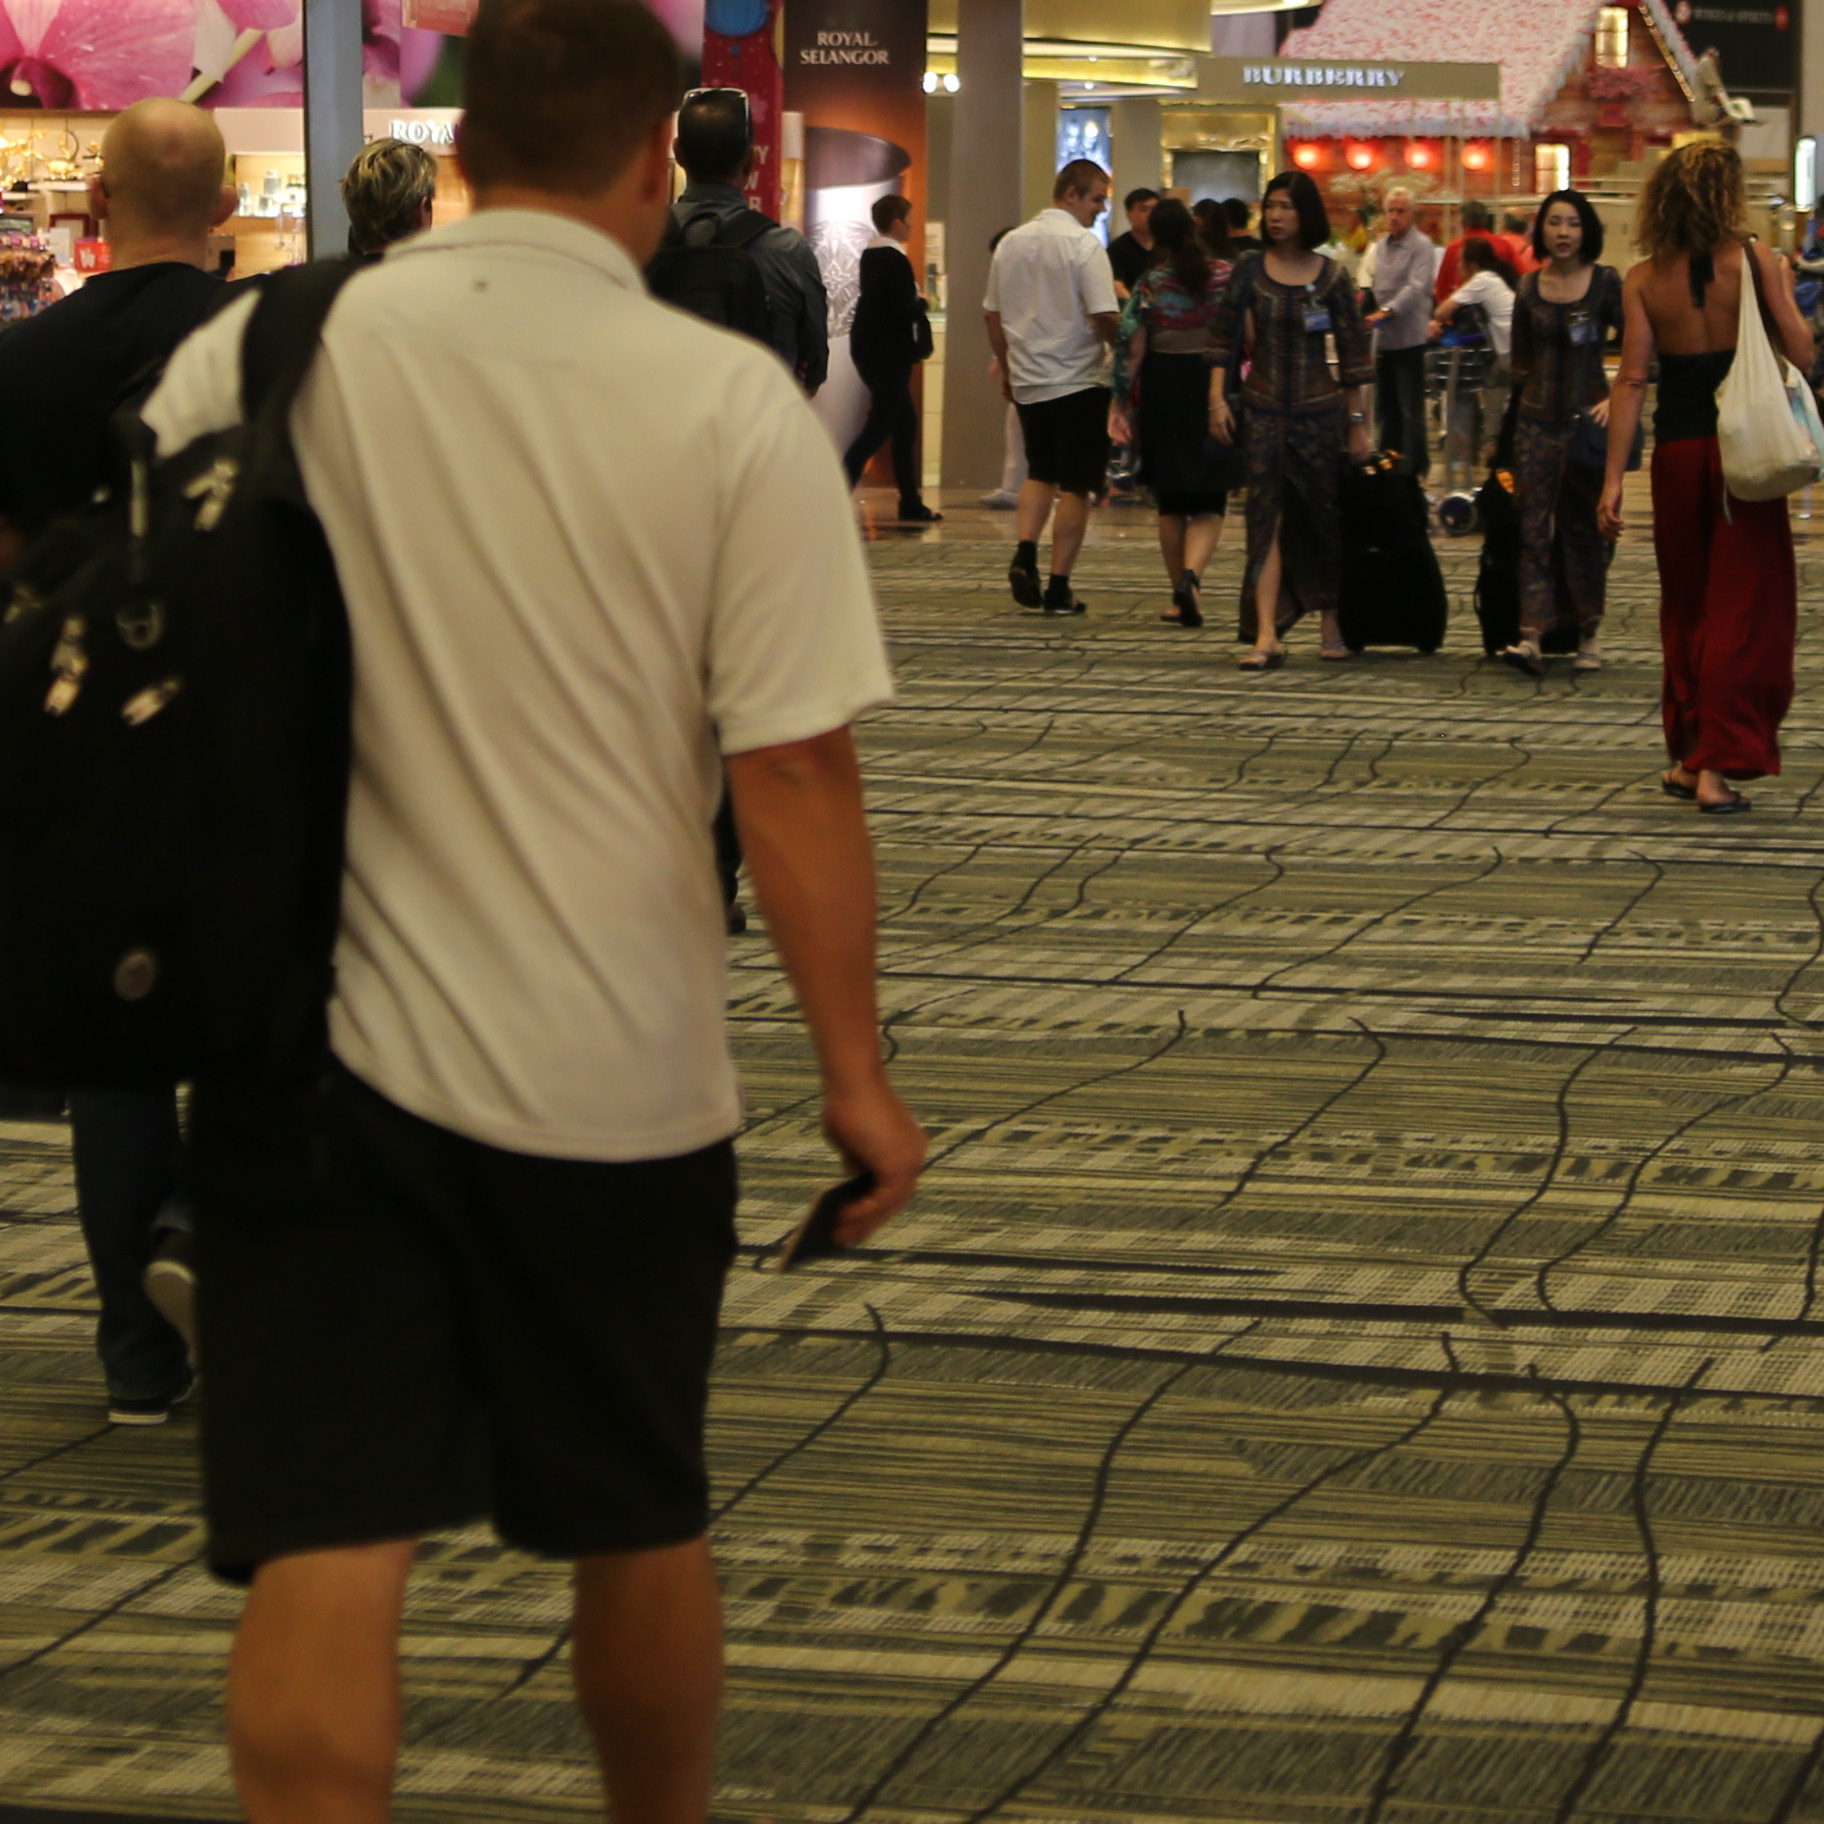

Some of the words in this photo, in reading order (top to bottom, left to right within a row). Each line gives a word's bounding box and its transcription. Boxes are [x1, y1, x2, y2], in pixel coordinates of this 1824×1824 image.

[817, 30, 879, 46] ROYAL
[800, 49, 890, 65] SELANGOR
[1243, 64, 1405, 87] BURBERRY
[390, 119, 455, 144] ROYA
